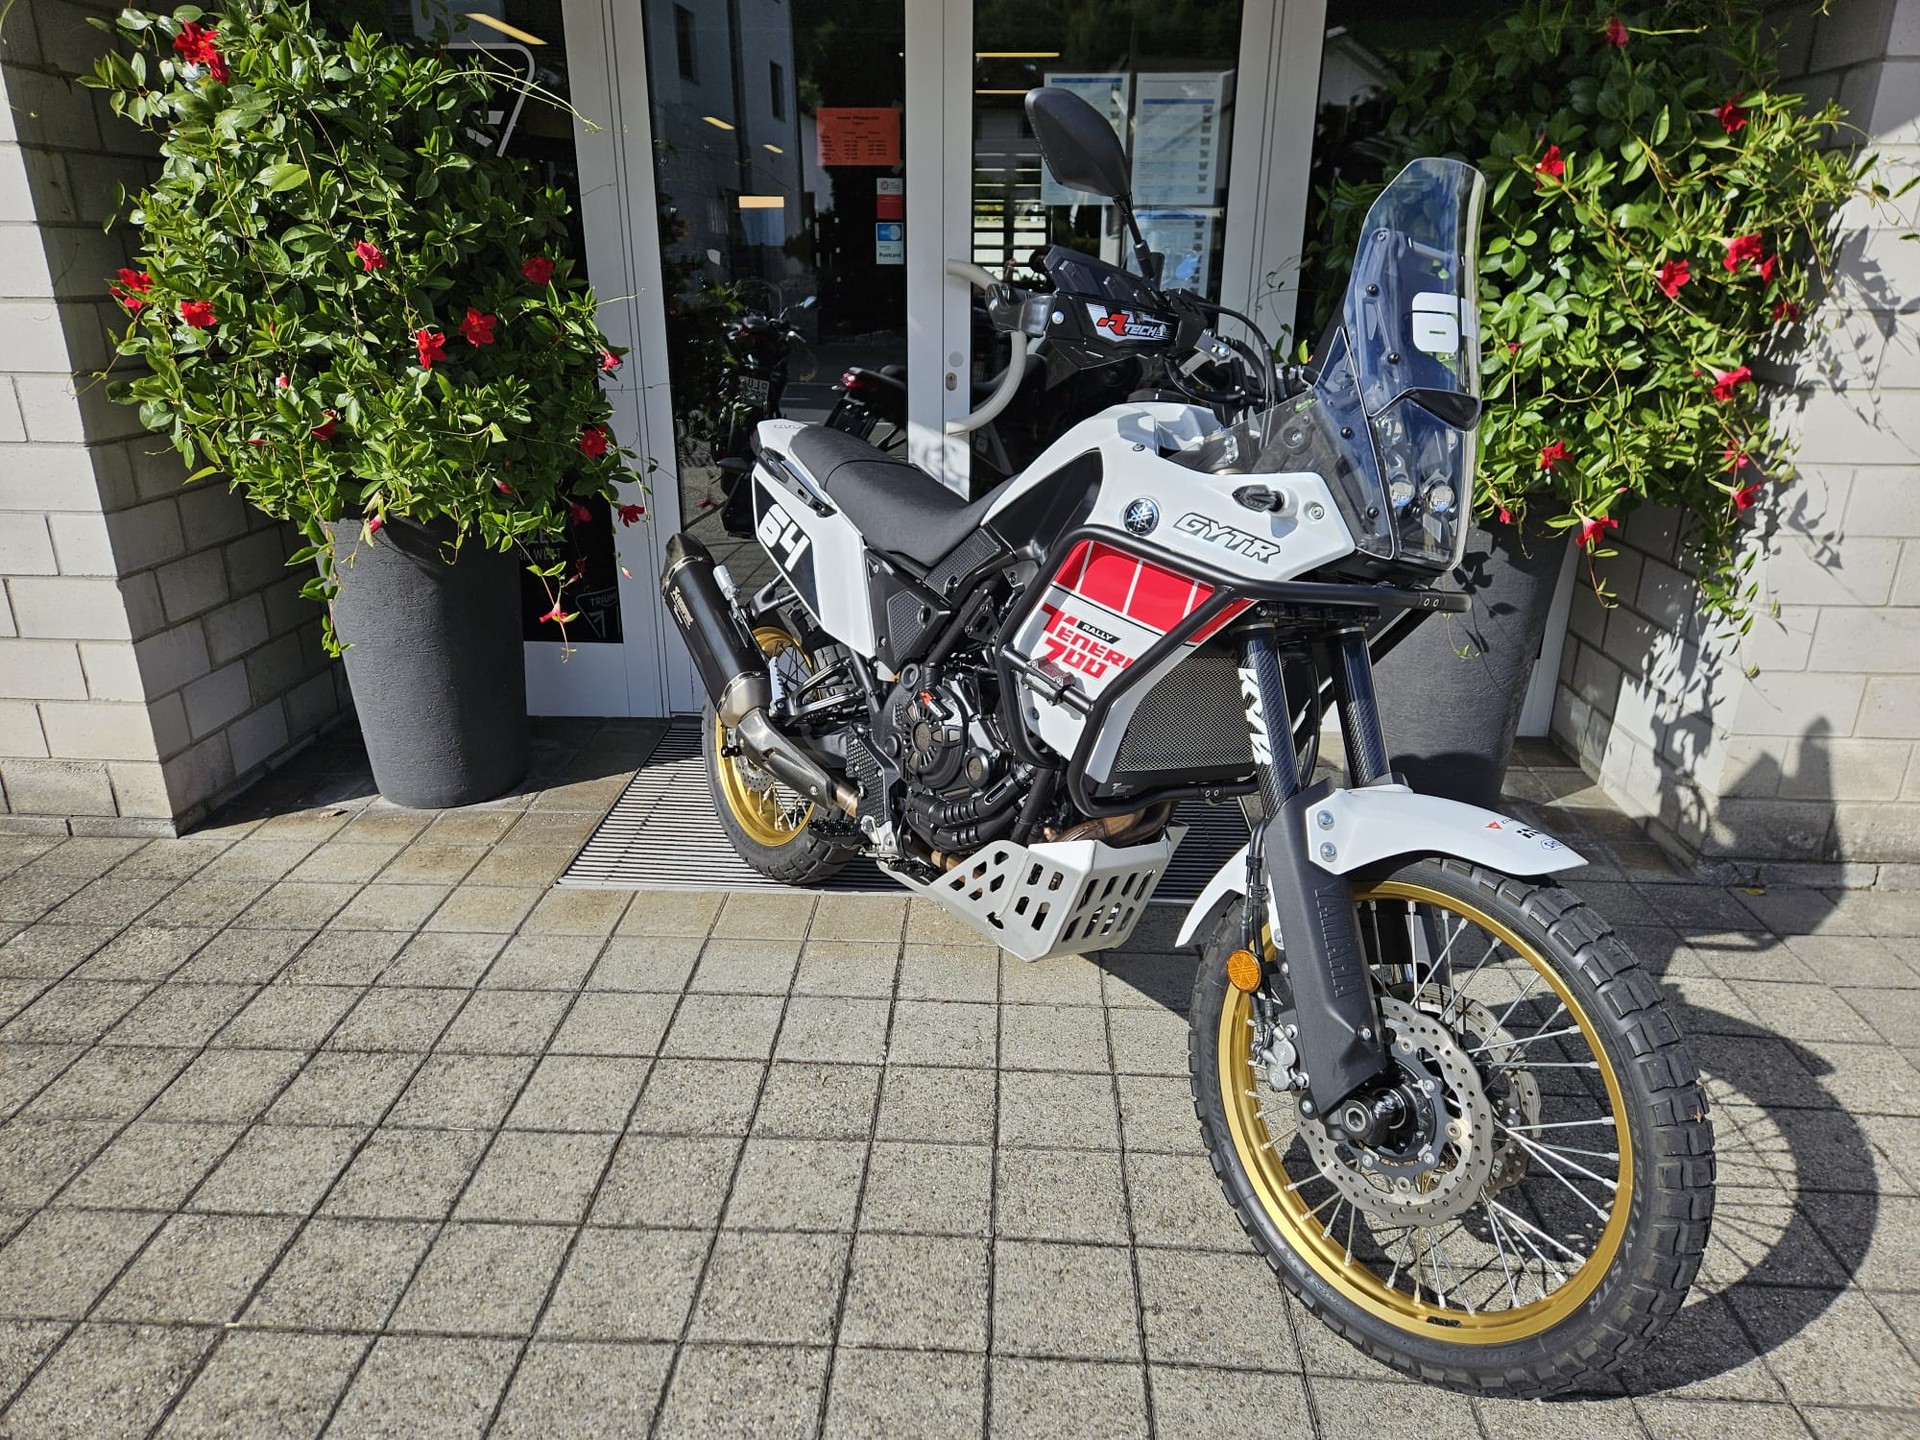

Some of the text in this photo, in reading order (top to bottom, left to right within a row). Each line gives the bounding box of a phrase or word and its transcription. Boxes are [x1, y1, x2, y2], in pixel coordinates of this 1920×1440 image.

[758, 503, 811, 573] 64
[1173, 512, 1282, 565] GYTR
[1044, 636, 1109, 679] 700
[1082, 624, 1114, 641] RALLY
[1238, 667, 1273, 765] KYB
[1314, 880, 1364, 998] YAMAHA
